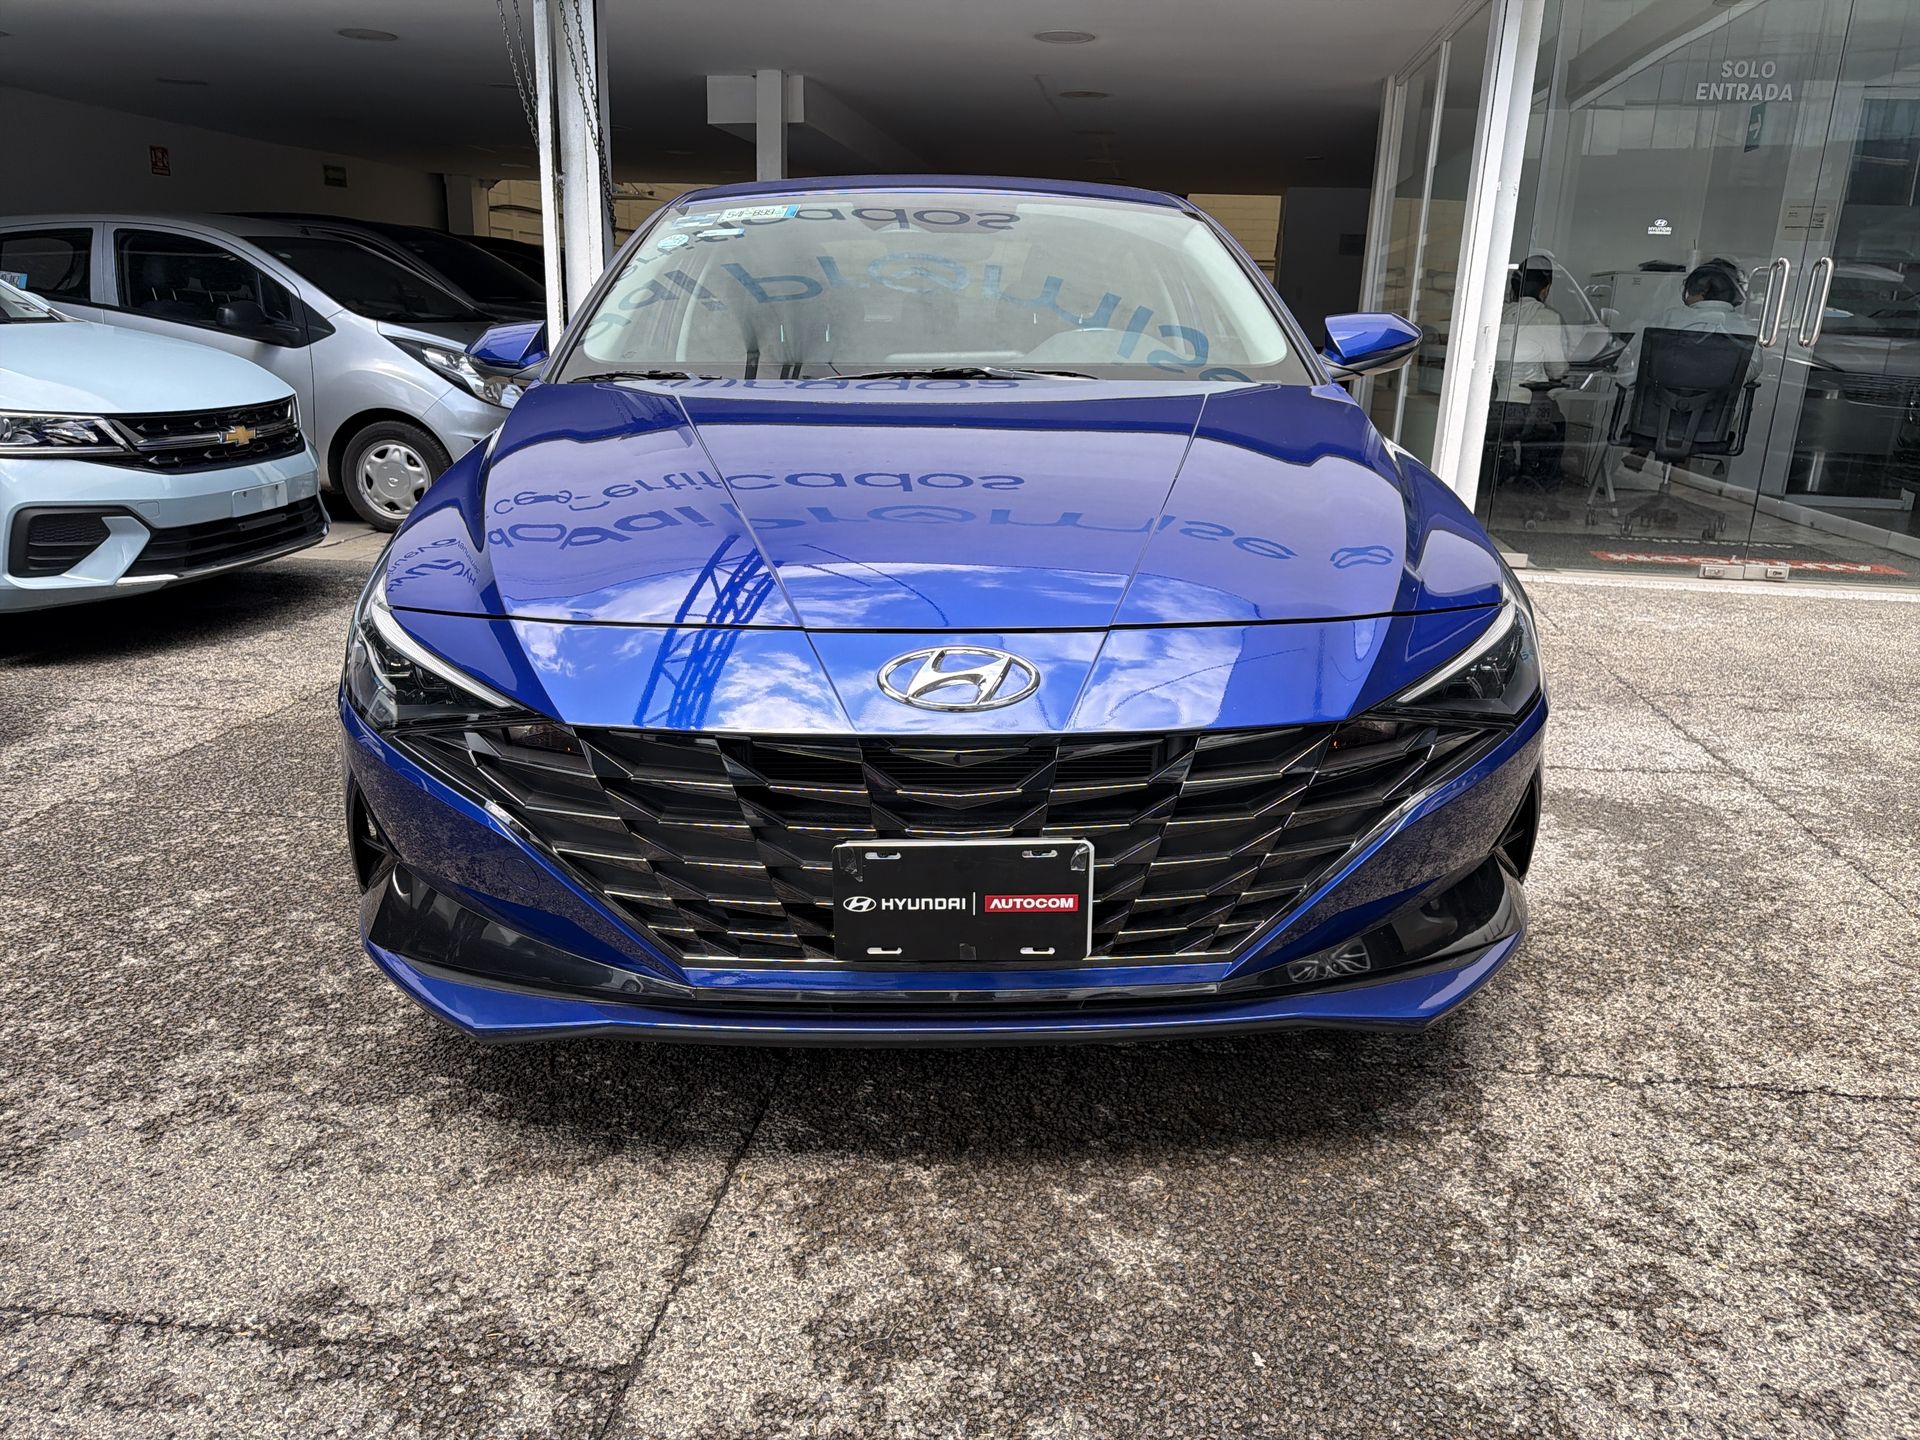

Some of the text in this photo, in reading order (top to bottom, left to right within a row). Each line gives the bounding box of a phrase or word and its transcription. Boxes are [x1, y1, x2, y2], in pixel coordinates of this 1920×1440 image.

[1721, 60, 1777, 78] SOLO
[1696, 82, 1793, 101] ENTRADA
[881, 897, 1074, 911] HYUNDAI AUTOCOM
